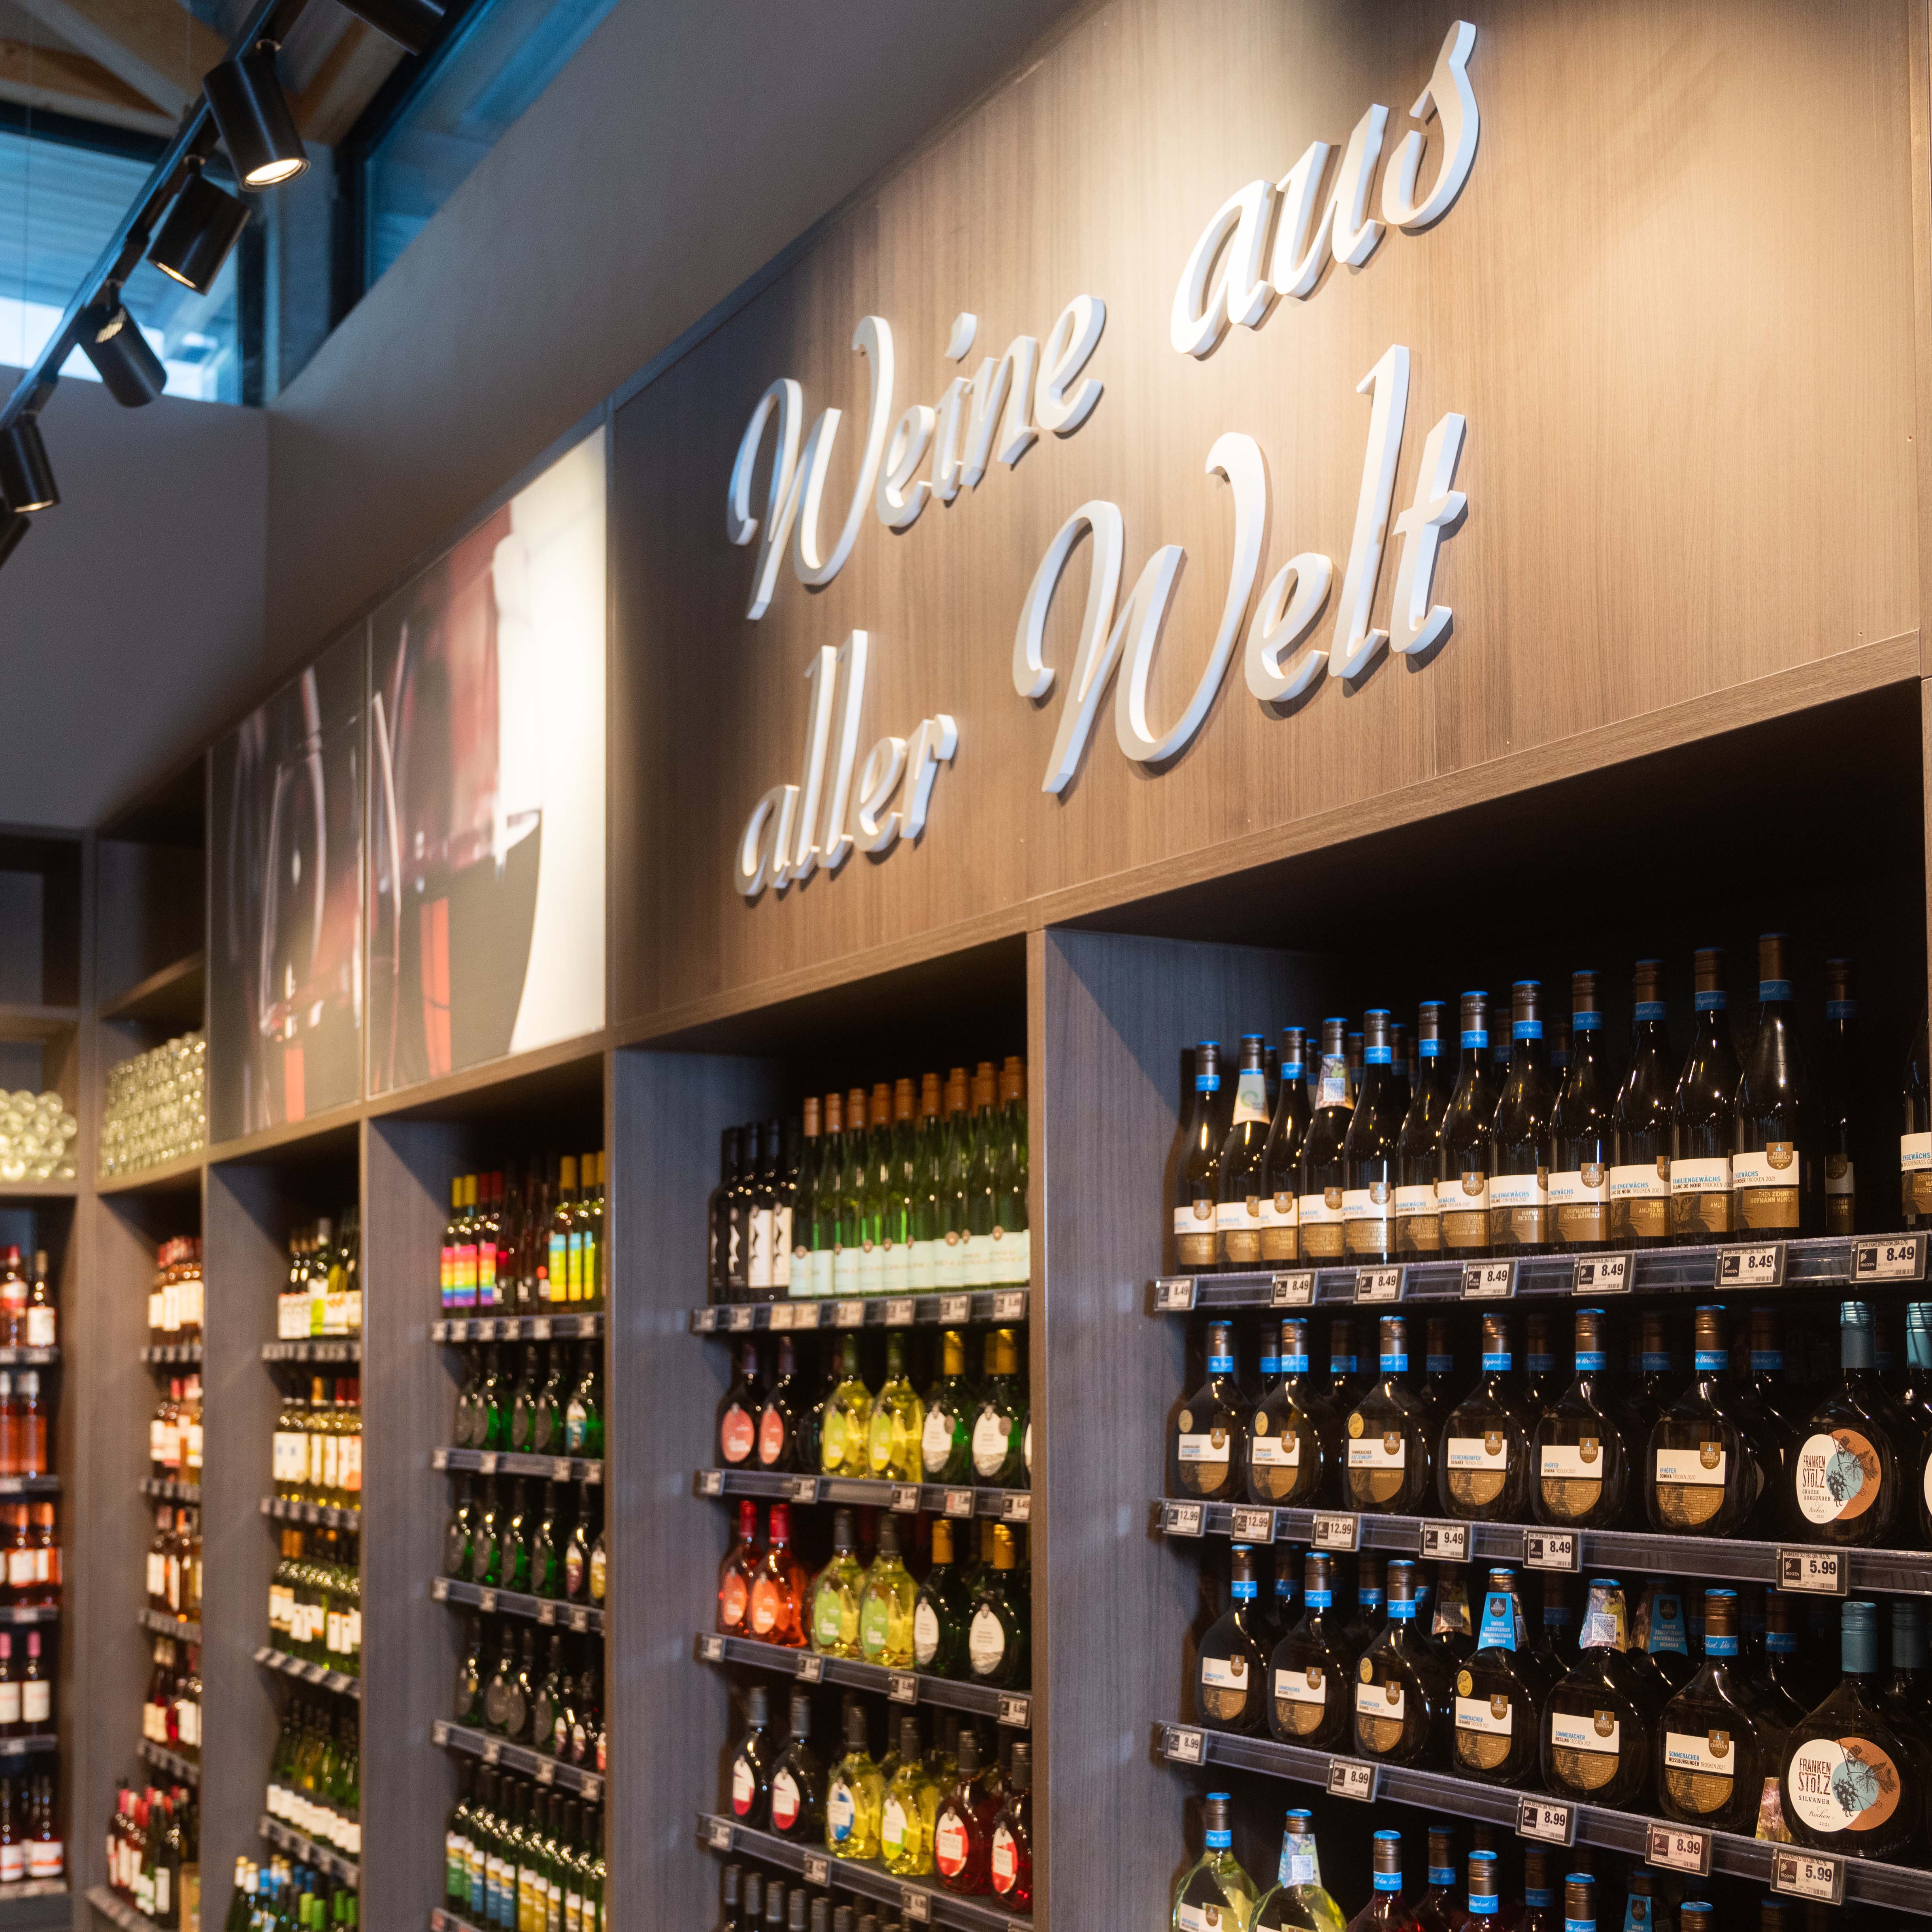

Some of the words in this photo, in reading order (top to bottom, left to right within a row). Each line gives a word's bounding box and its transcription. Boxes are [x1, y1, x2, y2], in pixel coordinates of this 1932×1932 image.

[727, 294, 1105, 620] Weine
[1170, 20, 1479, 357] aus
[735, 630, 957, 895] aller
[1013, 344, 1467, 793] Welt
[1673, 1175, 1721, 1184] FAMILIENGEWÄCHS
[1887, 1246, 1915, 1261] 8.49
[1749, 1255, 1773, 1268] 8.49
[1487, 1270, 1507, 1281] 8.49
[1602, 1264, 1623, 1276] 8.49
[1292, 1280, 1309, 1291] 8.49
[1378, 1275, 1396, 1287] 8.49
[1804, 1455, 1825, 1468] FRANKEN
[1802, 1468, 1825, 1488] STOLZ
[1180, 1510, 1198, 1521] 12.99
[1248, 1516, 1268, 1527] 12.99
[1330, 1523, 1351, 1534] 12.99
[1444, 1532, 1463, 1544] 9.49
[1550, 1541, 1571, 1553] 8.49
[1810, 1560, 1836, 1575] 5.99
[1556, 1731, 1585, 1740] SOMMERACHER
[1185, 1736, 1198, 1749] 8.99
[1669, 1751, 1699, 1761] SOMMERACHER
[1669, 1757, 1699, 1766] WEISSBURGUNDER
[1799, 1758, 1831, 1775] FRANKEN
[1351, 1771, 1369, 1784] 8.99
[1798, 1772, 1831, 1795] STOLZ
[1799, 1796, 1830, 1805] SILVANER
[1545, 1811, 1565, 1826] 8.99
[1809, 1806, 1834, 1820] trocken
[1677, 1838, 1700, 1855] 8.99
[1806, 1864, 1832, 1882] 5.99
